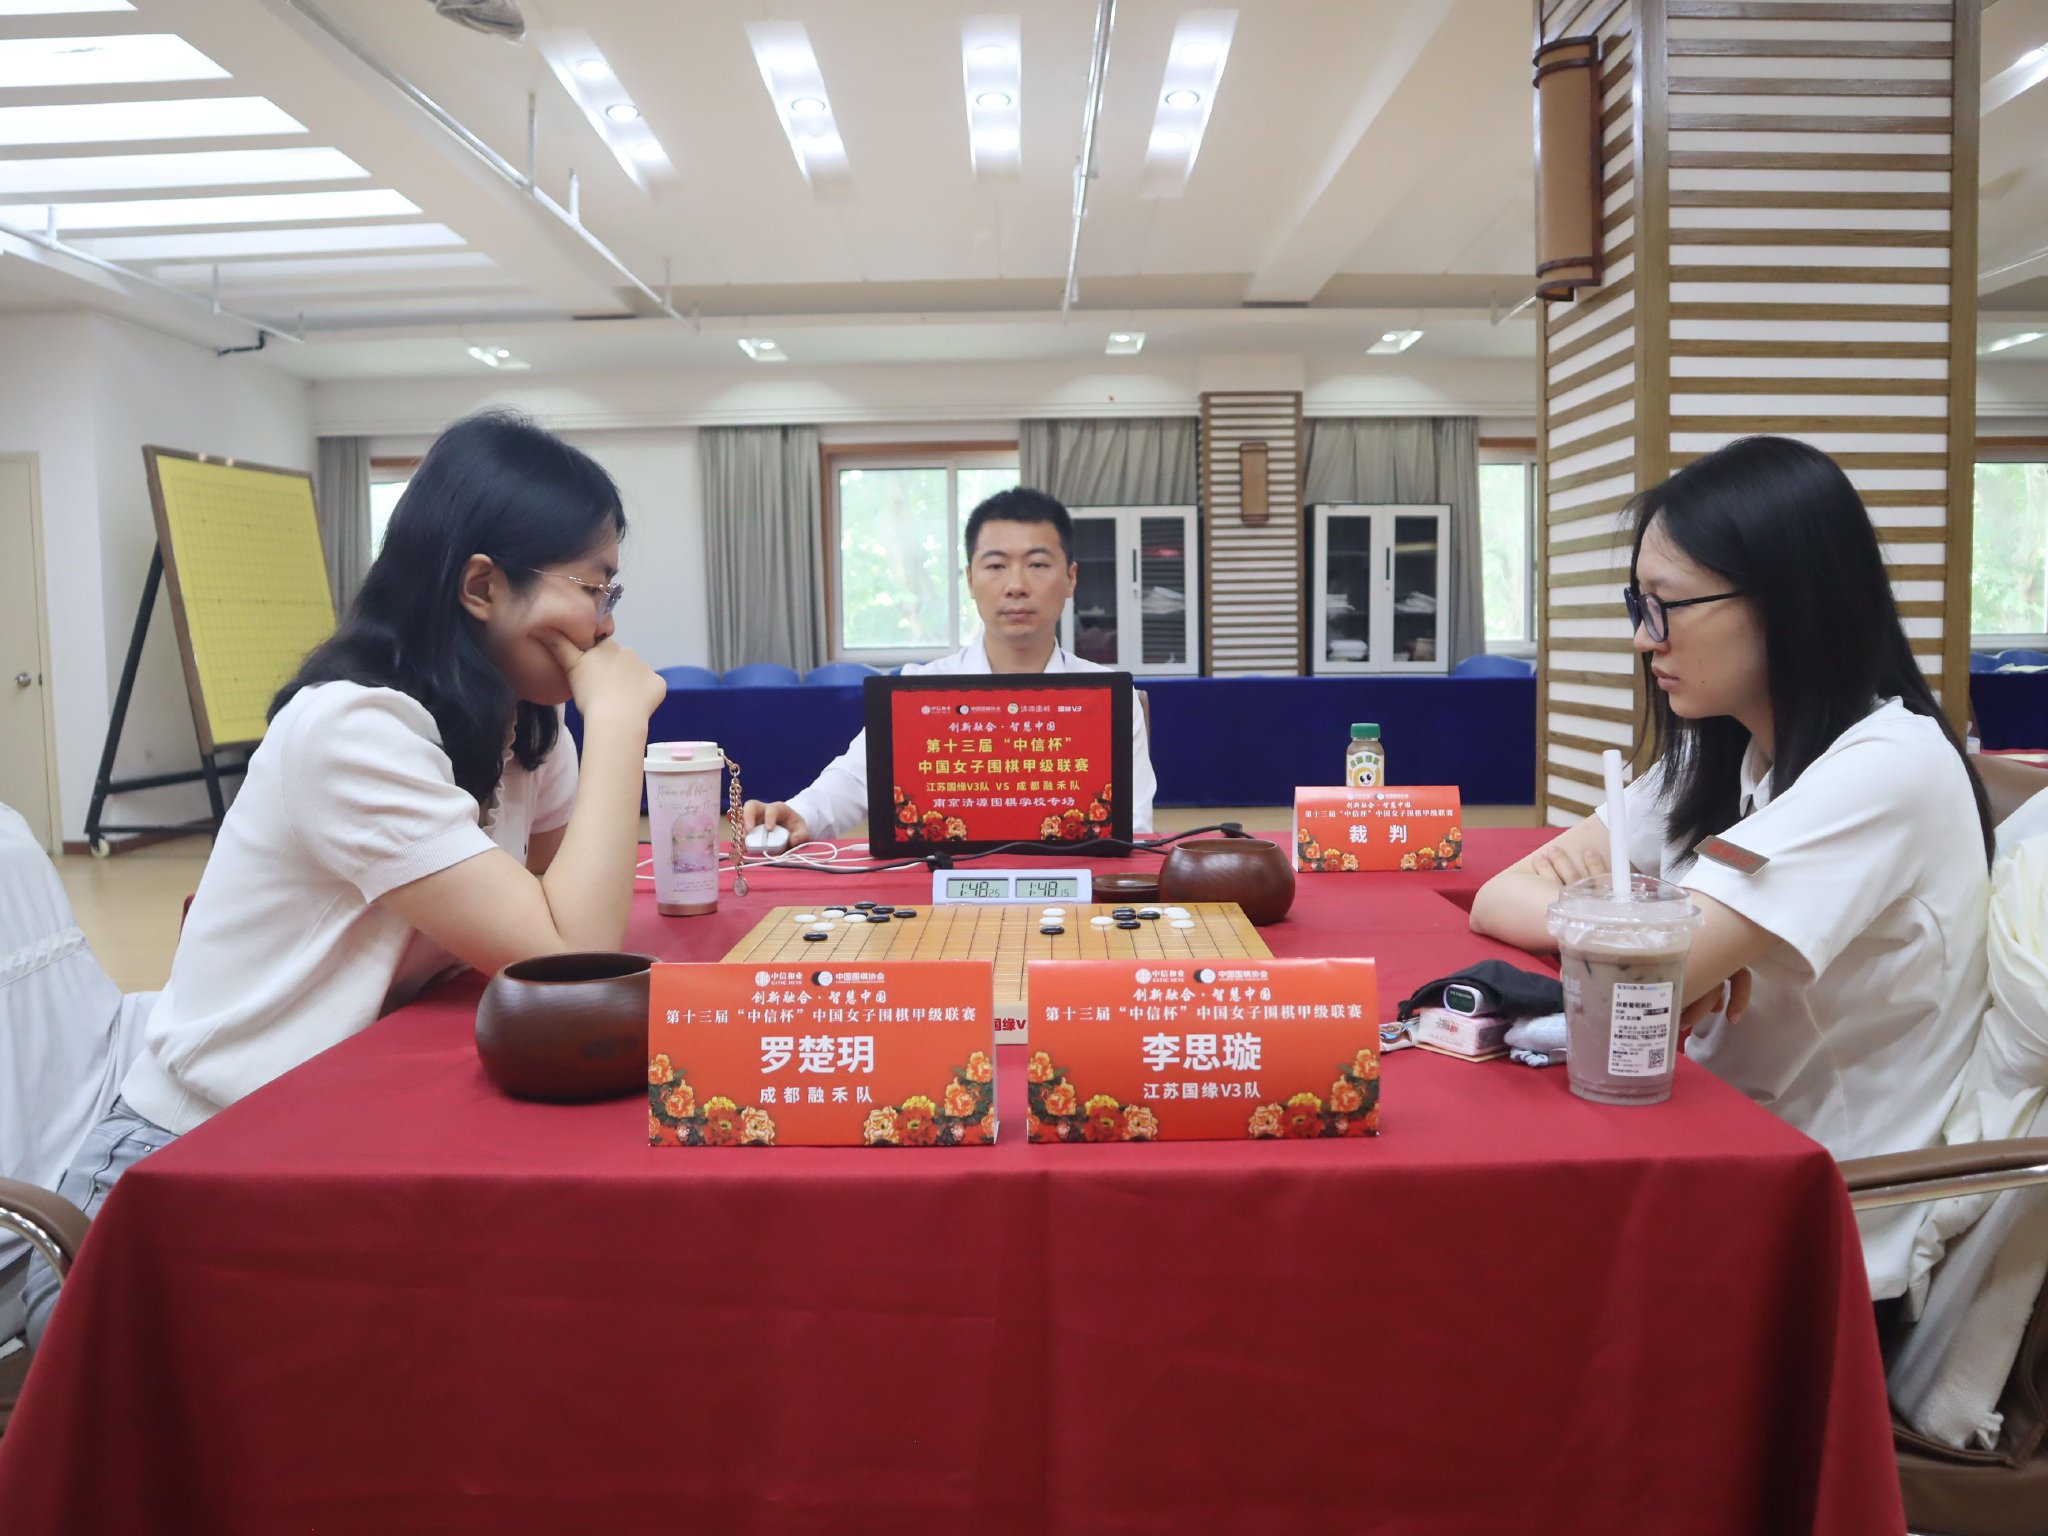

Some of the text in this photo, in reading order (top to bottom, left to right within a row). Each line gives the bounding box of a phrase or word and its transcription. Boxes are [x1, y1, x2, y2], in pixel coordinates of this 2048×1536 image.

[918, 757, 1089, 774] 中国女子围棋甲级联赛
[926, 780, 1080, 792] 江苏国缘V3队 VS 成都融禾队
[932, 796, 1076, 808] 南京清源围棋学校专场
[1349, 824, 1407, 844] 裁判
[960, 881, 1000, 898] 1:48 25
[1029, 881, 1058, 898] 1:48
[835, 972, 885, 980] 中国围棋协会
[1218, 970, 1268, 978] 中国围棋协会
[751, 989, 887, 1005] 创新融合·智慧中国
[1133, 987, 1272, 1002] 创新融合·智慧中国
[760, 1034, 874, 1074] 罗楚玥
[1142, 1031, 1263, 1072] 李思璇
[759, 1085, 873, 1104] 成都融禾队
[1143, 1081, 1262, 1100] 江苏国缘V3队
